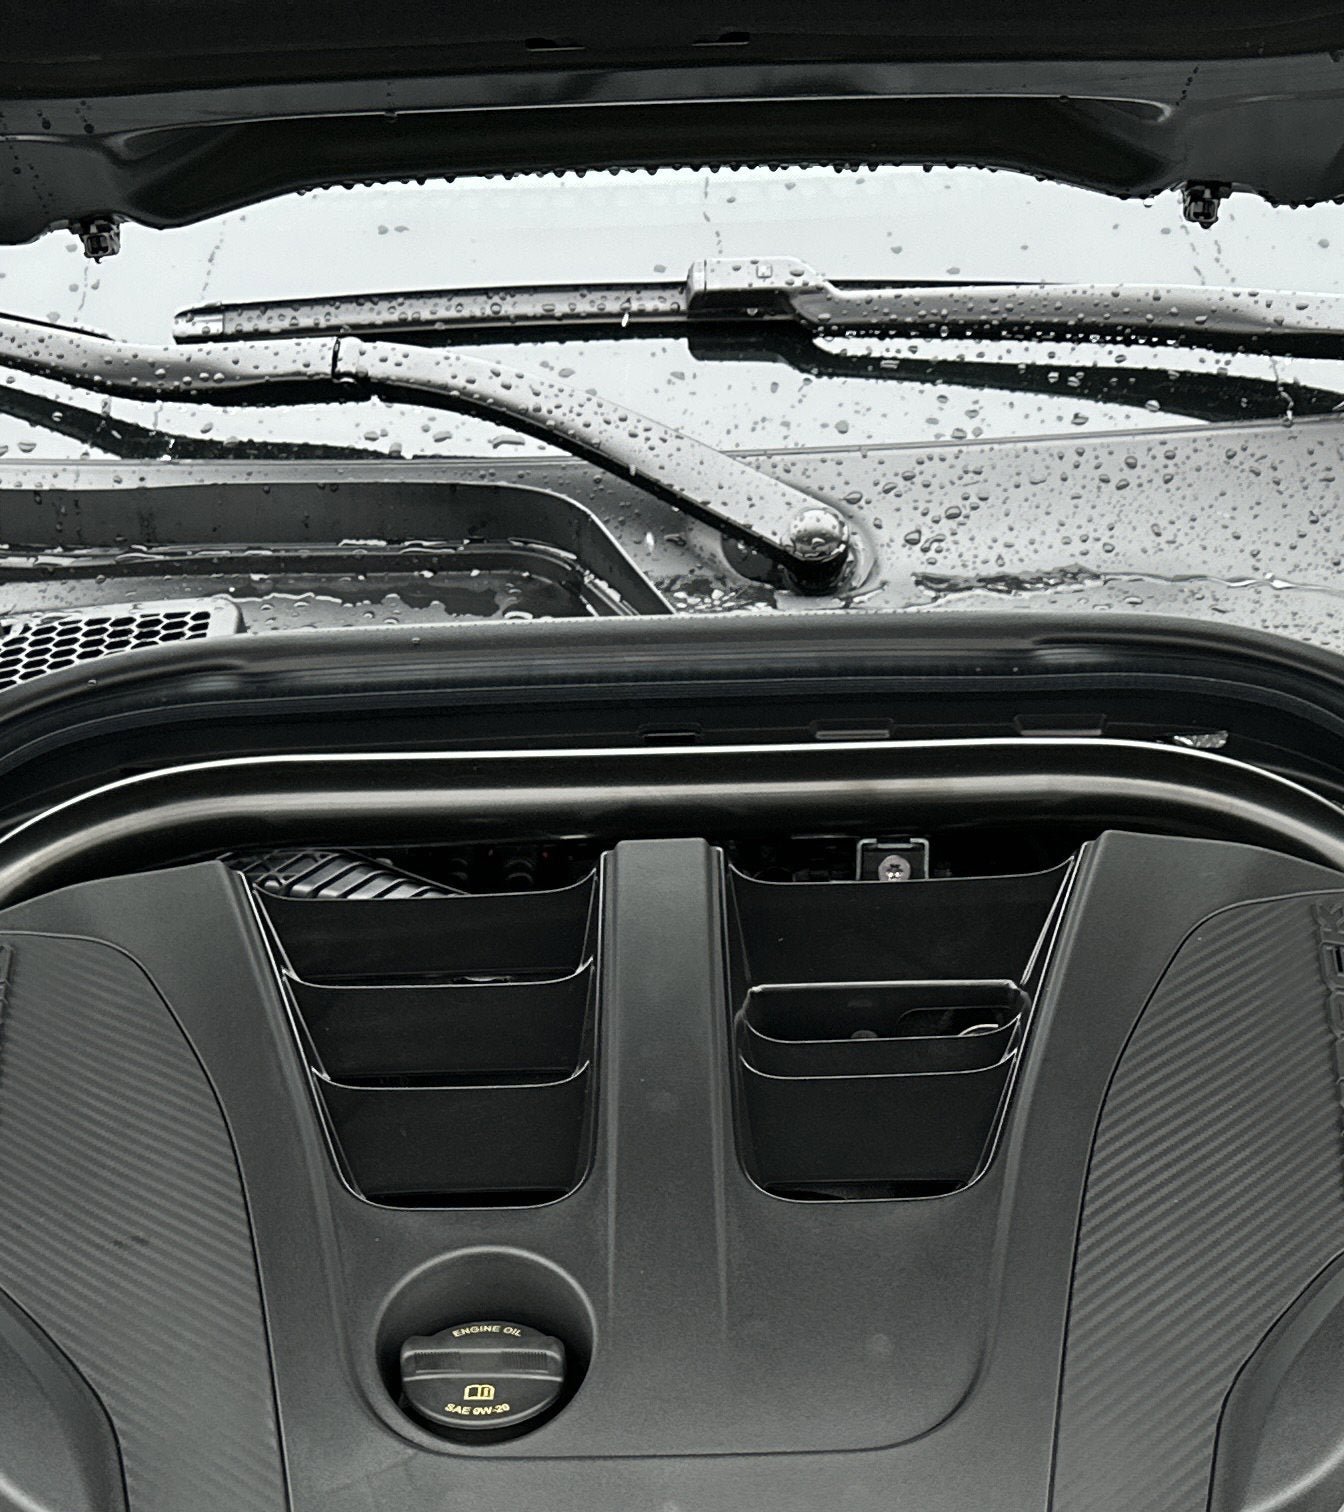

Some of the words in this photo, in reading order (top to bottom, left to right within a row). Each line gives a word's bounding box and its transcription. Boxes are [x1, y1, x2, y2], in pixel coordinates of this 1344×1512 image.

[451, 1324, 500, 1338] ENGINE
[503, 1326, 523, 1338] OIL
[444, 1403, 471, 1415] SAE
[472, 1403, 510, 1415] 0W-20
